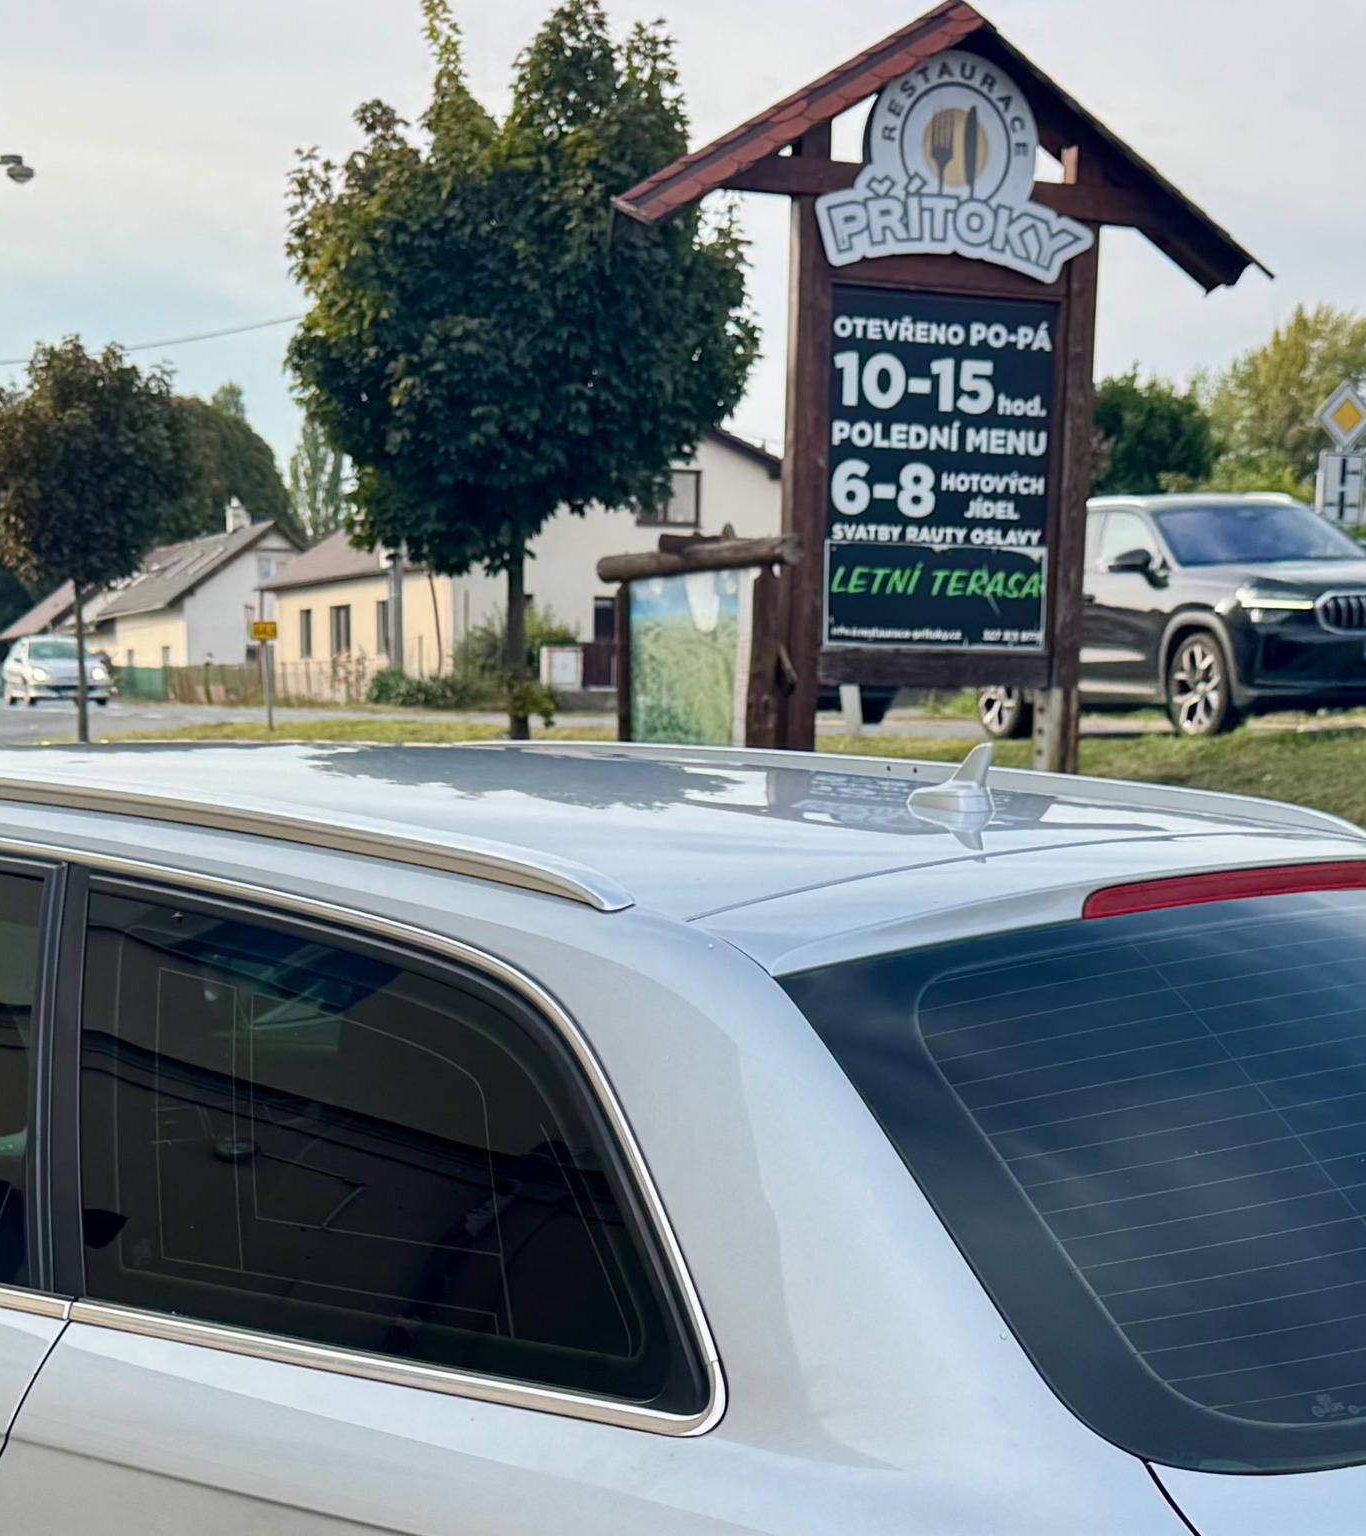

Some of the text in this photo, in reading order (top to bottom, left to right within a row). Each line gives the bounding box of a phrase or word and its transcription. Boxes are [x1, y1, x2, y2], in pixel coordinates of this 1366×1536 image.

[882, 61, 1029, 158] RESTAURACE
[826, 172, 1084, 272] PŘÍTOKY
[833, 315, 1052, 351] OTEVŘENO PO-PÁ
[833, 350, 1047, 417] 10-15 hod.
[831, 419, 1048, 456] POLEDNÍ MENU
[831, 458, 1046, 519] 6-8 HOTOVÝCH
[963, 496, 1021, 520] JÍDEL
[831, 522, 1043, 546] SVATBY RAUTY OSLAVY
[830, 561, 1042, 598] LETNÍ TERASA
